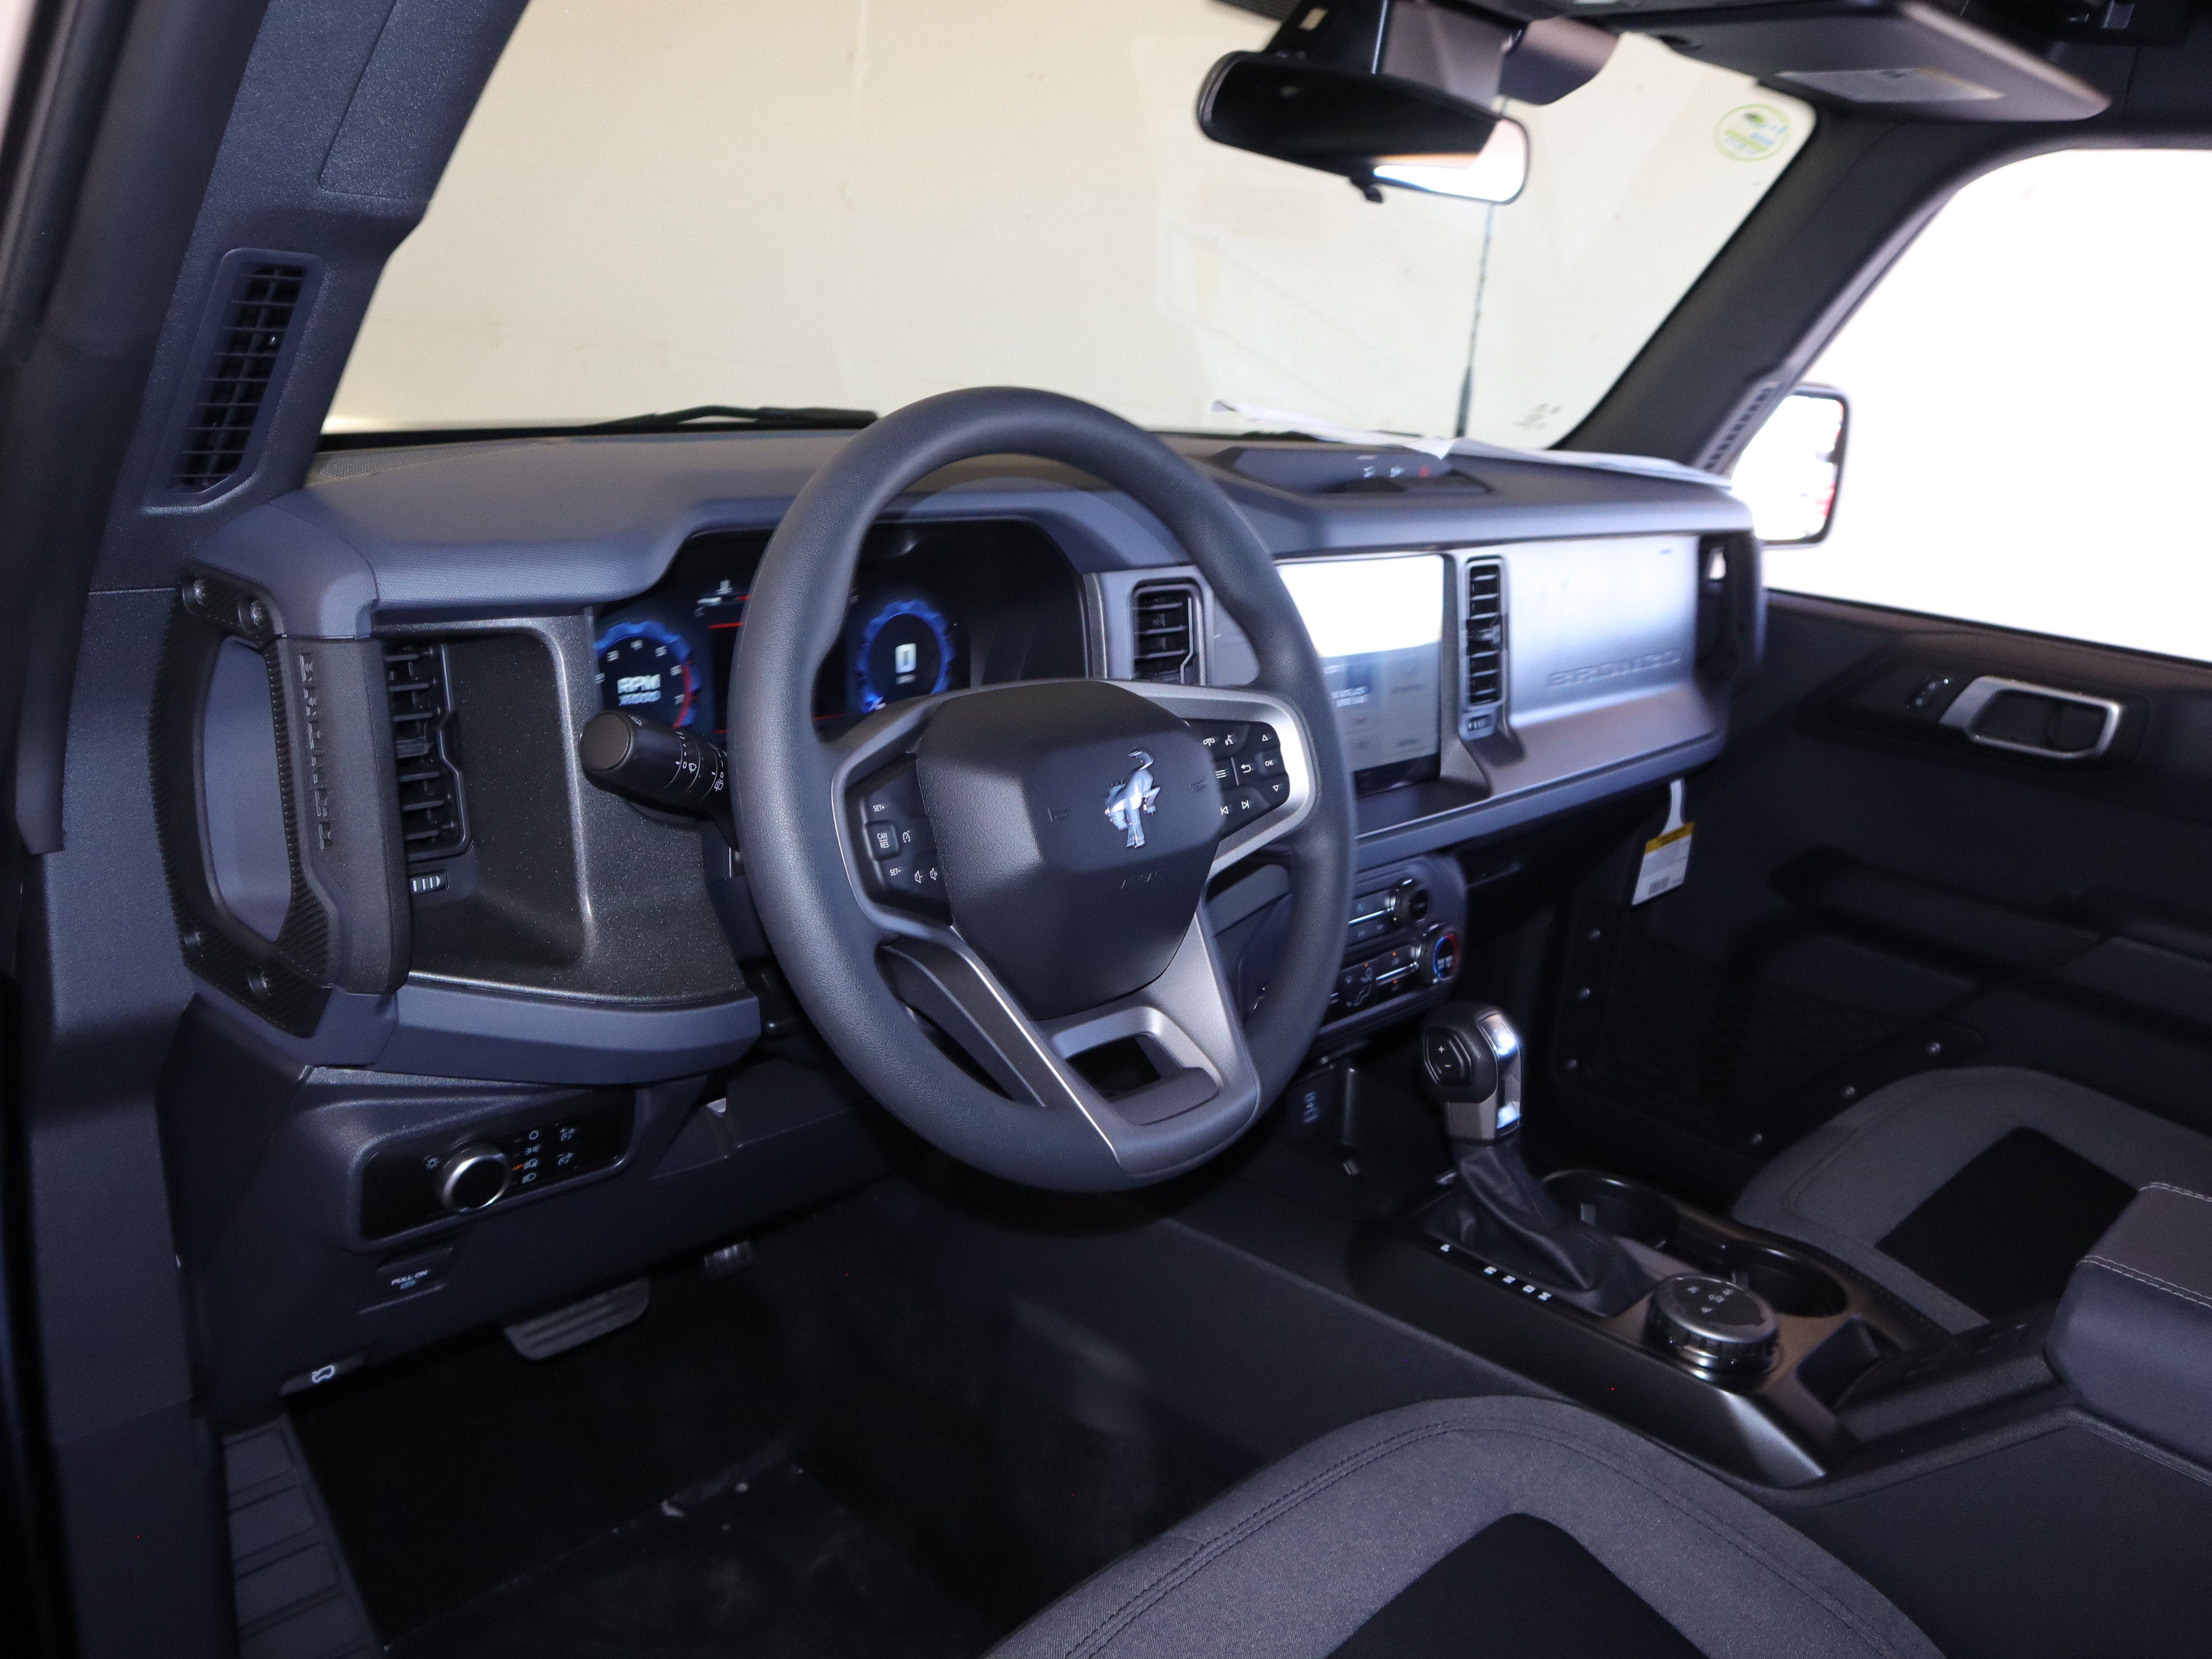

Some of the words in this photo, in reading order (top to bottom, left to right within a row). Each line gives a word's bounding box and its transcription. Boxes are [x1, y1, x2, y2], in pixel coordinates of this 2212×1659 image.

[895, 643, 917, 673] 0
[1548, 649, 1681, 688] BRONCO
[617, 674, 661, 694] RPM
[873, 803, 885, 812] SET+
[877, 832, 888, 840] CAN
[889, 868, 901, 876] SET-
[1440, 1244, 1450, 1252] P
[1522, 1285, 1536, 1293] D
[391, 1275, 412, 1286] PULL
[414, 1270, 428, 1279] ON
